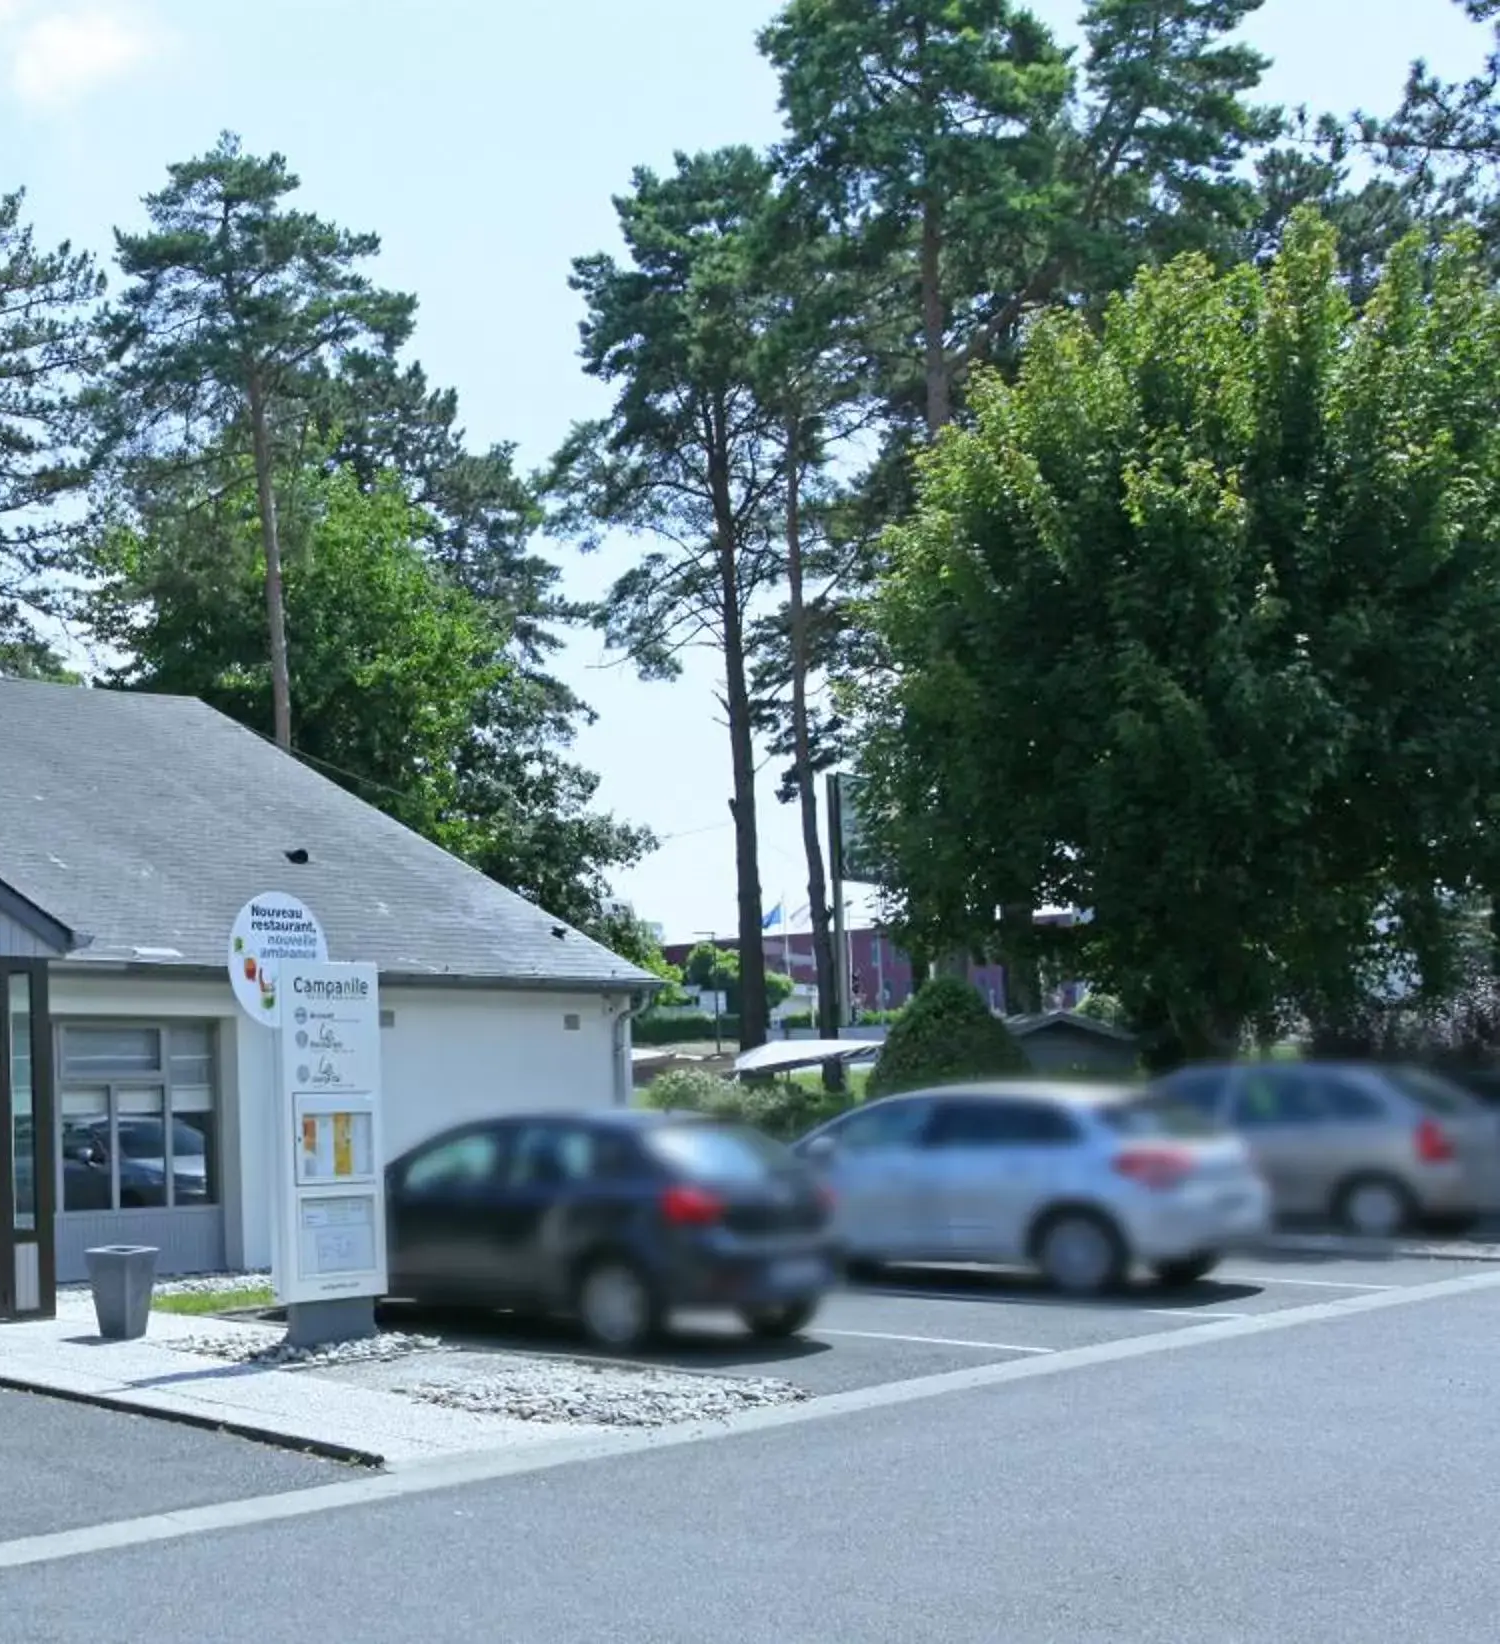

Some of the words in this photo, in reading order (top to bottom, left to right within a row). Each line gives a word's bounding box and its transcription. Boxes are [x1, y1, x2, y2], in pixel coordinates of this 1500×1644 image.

[251, 904, 303, 919] Nouveau
[251, 920, 317, 933] restaurant,
[293, 976, 369, 998] Campanile
